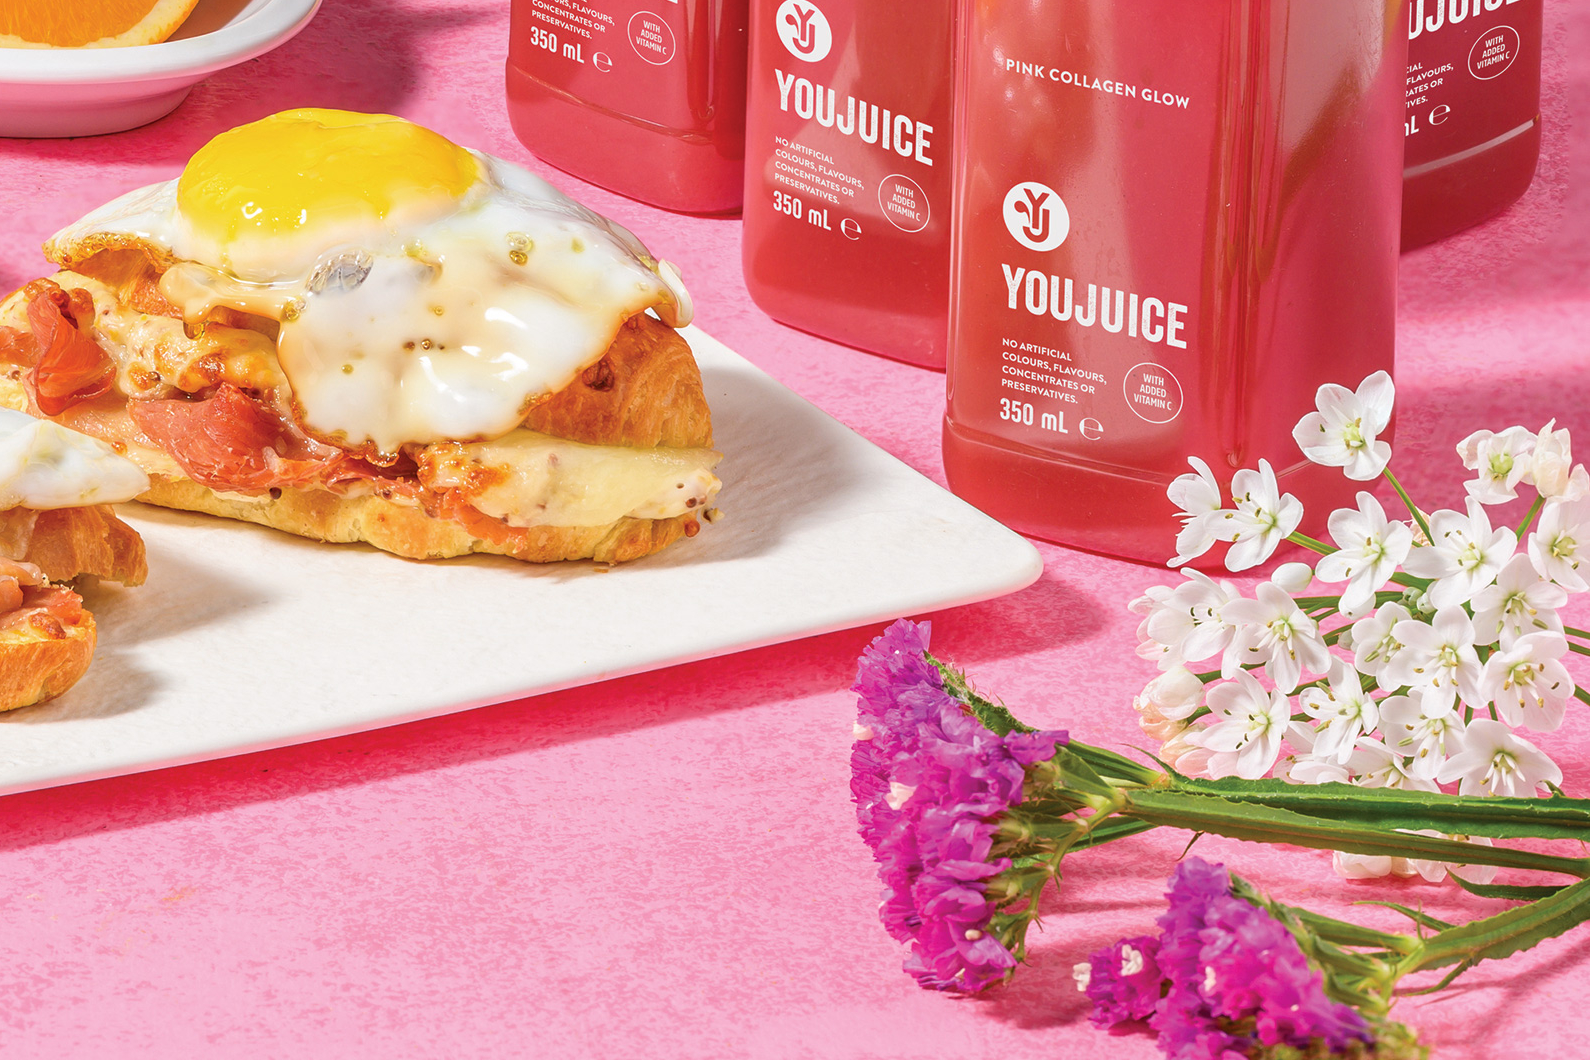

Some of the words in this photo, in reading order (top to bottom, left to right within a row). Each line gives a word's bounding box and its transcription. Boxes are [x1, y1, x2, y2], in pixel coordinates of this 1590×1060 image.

[532, 10, 592, 39] PRESERVATIVES.
[533, 0, 592, 28] CONCENTRATES
[594, 22, 605, 32] OR
[572, 3, 615, 26] FLAVOURS,
[643, 20, 660, 32] WITH
[530, 26, 557, 53] 350
[563, 44, 584, 64] mL
[636, 36, 661, 53] VITAMIN
[662, 47, 667, 55] C
[641, 30, 662, 44] ADDED
[1485, 35, 1504, 48] WITH
[1477, 53, 1504, 70] VITAMIN
[1505, 51, 1510, 59] C
[1482, 44, 1505, 59] ADDED
[1006, 59, 1045, 78] PINK
[1049, 68, 1136, 98] COLLAGEN
[1142, 89, 1190, 109] GLOW
[1406, 63, 1453, 85] FLAVOURS,
[1430, 78, 1443, 87] OR
[775, 69, 933, 166] YOUJUICE
[776, 136, 788, 146] NO
[790, 142, 834, 165] ARTIFICIAL
[775, 161, 840, 191] CONCENTRATES
[842, 185, 854, 197] OR
[776, 149, 817, 172] COLOURS,
[818, 166, 864, 190] FLAVOURS,
[775, 173, 840, 205] PRESERVATIVES.
[895, 184, 914, 198] WITH
[773, 191, 802, 219] 350
[808, 208, 831, 231] mL
[887, 202, 914, 219] VITAMIN
[916, 212, 920, 221] C
[892, 194, 915, 208] ADDED
[1002, 264, 1188, 349] YOUJUICE
[1003, 338, 1018, 348] NO
[1019, 342, 1072, 361] ARTIFICIAL
[1002, 352, 1052, 372] COLOURS,
[1054, 364, 1107, 385] FLAVOURS,
[1002, 365, 1079, 390] CONCENTRATES
[1080, 384, 1095, 394] OR
[1143, 373, 1164, 386] WITH
[1002, 379, 1079, 404] PRESERVATIVES.
[1134, 393, 1166, 409] VITAMIN
[1167, 401, 1172, 411] C
[1140, 384, 1167, 398] ADDED
[1000, 398, 1033, 426] 350
[1042, 411, 1068, 434] mL
